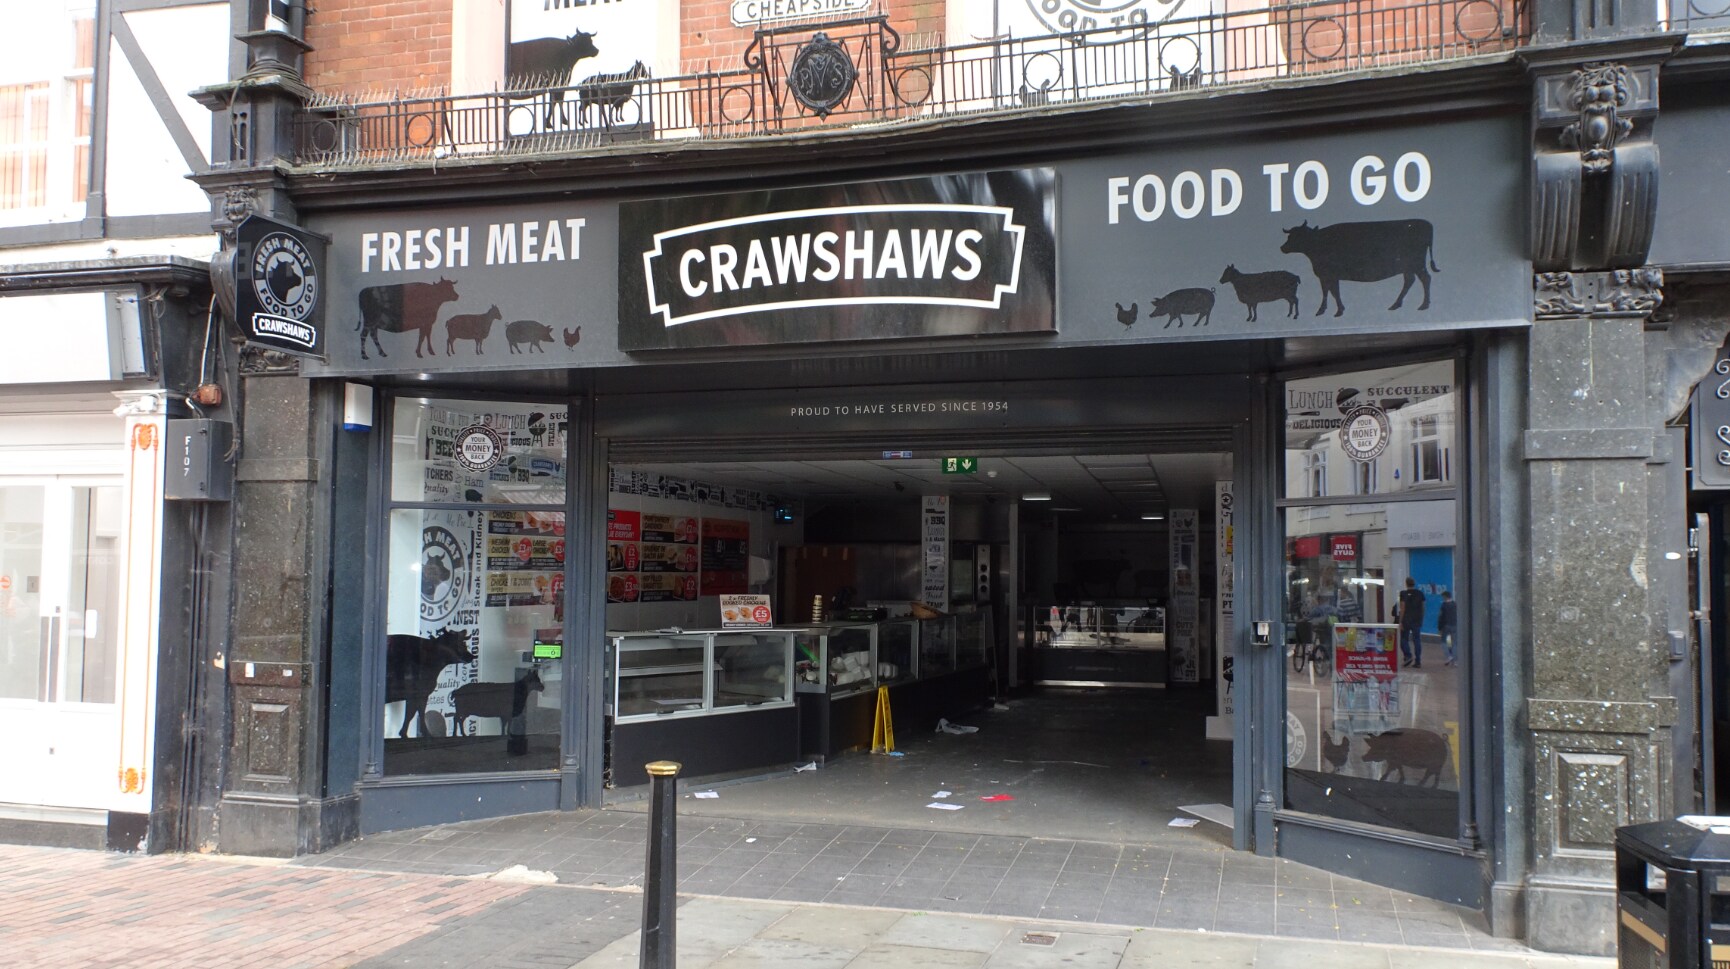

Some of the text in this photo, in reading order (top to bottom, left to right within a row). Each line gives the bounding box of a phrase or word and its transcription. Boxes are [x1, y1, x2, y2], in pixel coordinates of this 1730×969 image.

[1108, 151, 1432, 225] FOOD TO GO
[361, 218, 585, 273] FRESH MEAT
[255, 238, 311, 273] FRESH MEAT
[679, 229, 983, 298] CRAWSHAWS
[260, 283, 314, 318] FOOD TO GO
[258, 318, 311, 341] CRAWSHAWS
[1288, 390, 1333, 409] LUNCH
[1367, 385, 1450, 397] SUCCULENT
[791, 401, 1009, 416] PROUD TO HAVE SERVED SINCE 1954
[495, 413, 526, 430] LUNCH
[1292, 418, 1341, 430] DELICIOUS
[1352, 428, 1378, 438] MONEY
[1357, 440, 1385, 458] GUARANTEE
[470, 455, 497, 468] GUARANTEE
[465, 476, 484, 487] Ham
[475, 510, 484, 549] Kidney
[435, 531, 460, 560] MEAT
[452, 576, 461, 598] GO
[473, 576, 481, 607] Steak
[755, 610, 768, 618] £5
[435, 679, 460, 691] uality
